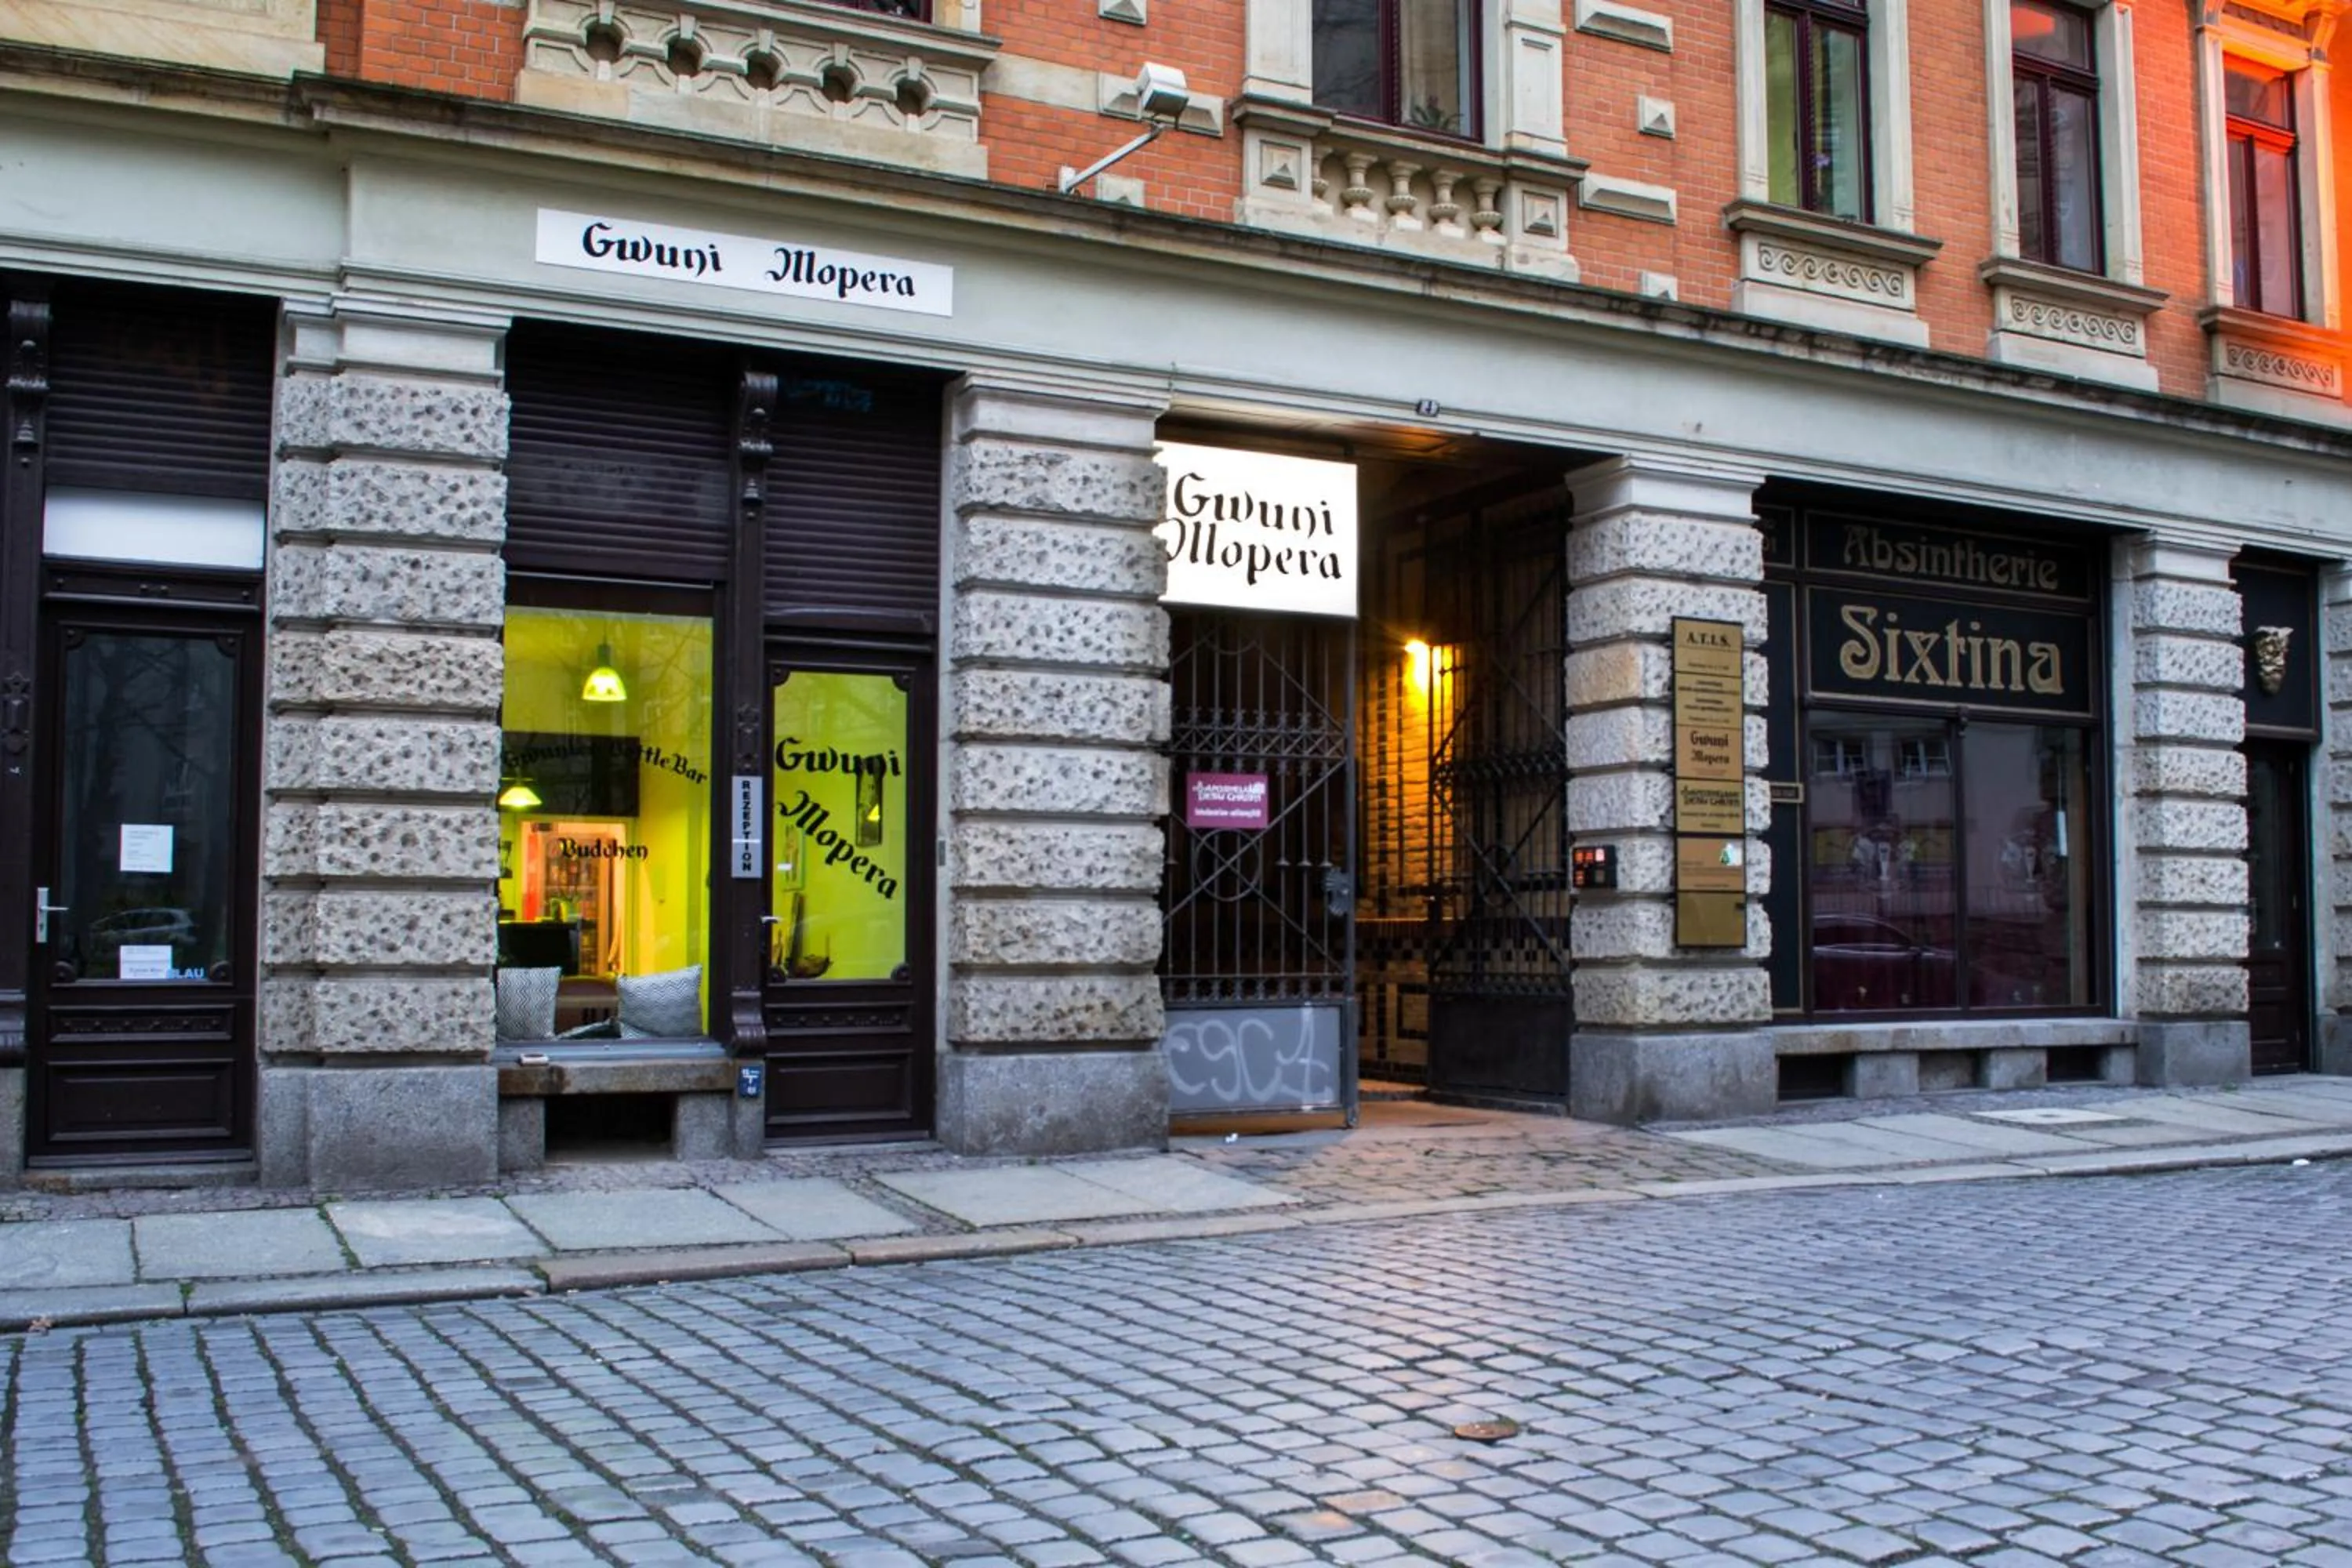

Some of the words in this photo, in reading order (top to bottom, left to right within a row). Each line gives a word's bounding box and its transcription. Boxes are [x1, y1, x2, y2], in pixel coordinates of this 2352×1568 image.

[582, 222, 723, 277] Gwuni
[765, 247, 916, 298] Mopera
[1174, 472, 1333, 539] Gwuni
[1166, 517, 1341, 586] Mopera
[1842, 524, 2060, 590] Absintherie
[1839, 604, 2064, 695] Sixtina
[670, 753, 708, 784] Bar
[775, 737, 902, 777] Gwuni
[741, 779, 753, 873] REZEPTION
[777, 789, 898, 900] Mopera
